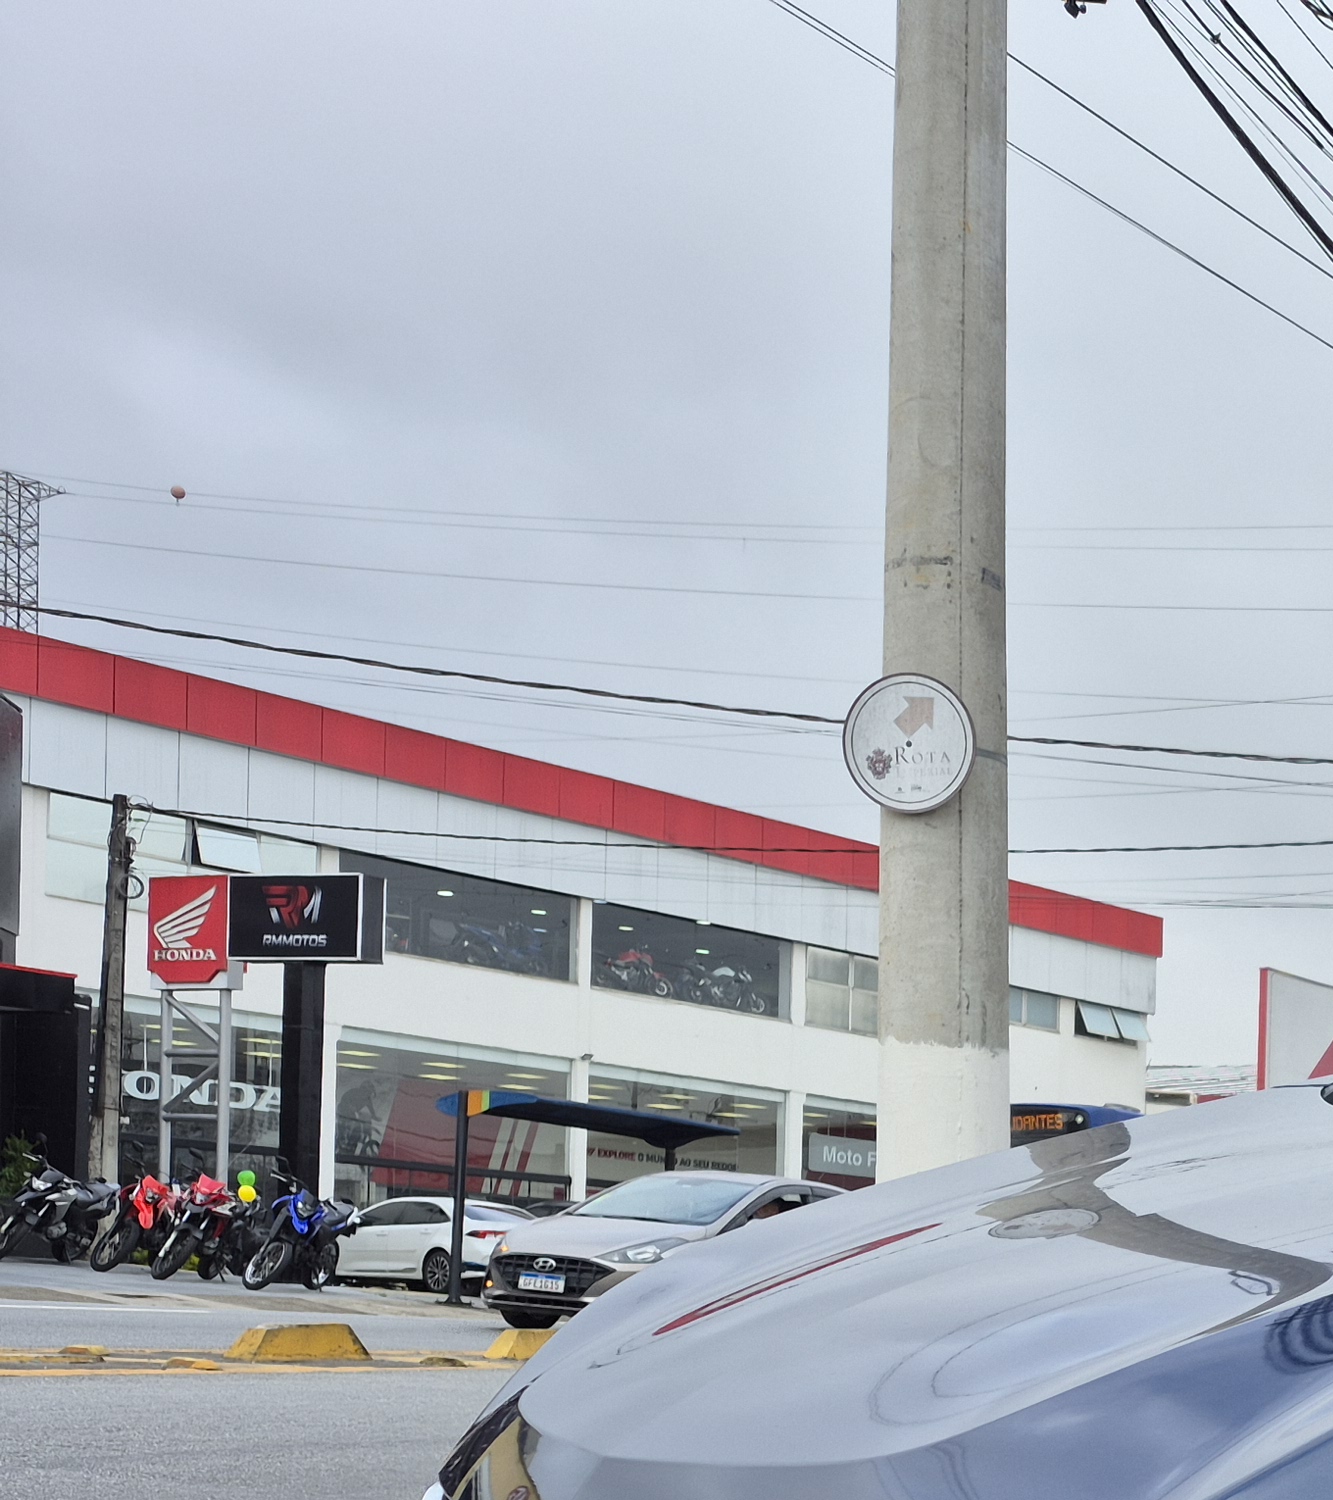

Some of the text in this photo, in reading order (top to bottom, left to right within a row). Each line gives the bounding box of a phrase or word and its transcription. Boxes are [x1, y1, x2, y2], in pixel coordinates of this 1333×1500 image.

[262, 933, 328, 948] RMMOTOS
[153, 948, 218, 962] HONDA
[121, 1068, 281, 1113] ONDA
[823, 1146, 862, 1166] Moto
